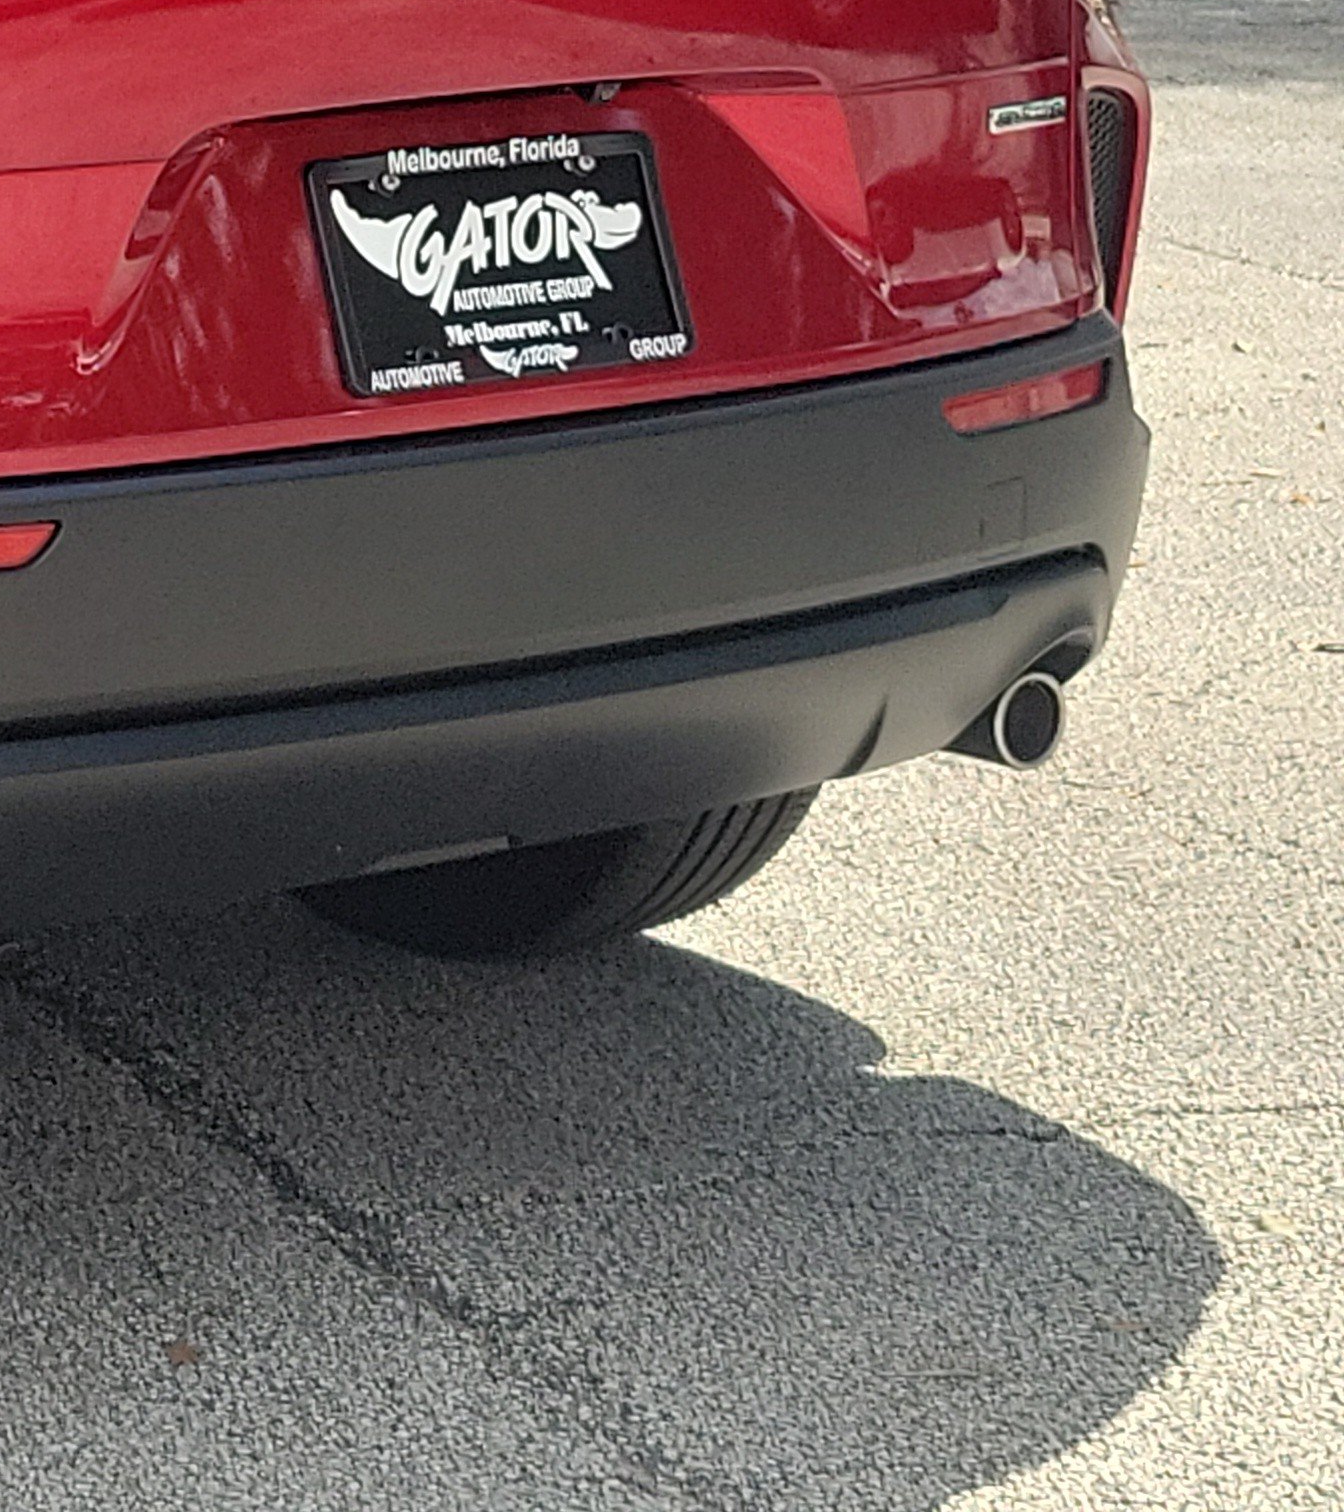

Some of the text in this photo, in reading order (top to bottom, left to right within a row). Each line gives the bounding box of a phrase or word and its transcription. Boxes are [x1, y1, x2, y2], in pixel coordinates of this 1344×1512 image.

[387, 134, 581, 175] Melbourne, Florida
[399, 191, 613, 317] GATOR
[453, 275, 595, 313] AUTOMOTIVE GROUP
[504, 343, 569, 379] GATOR
[628, 333, 687, 361] GROUP
[370, 362, 465, 392] AUTOMOTIVE
